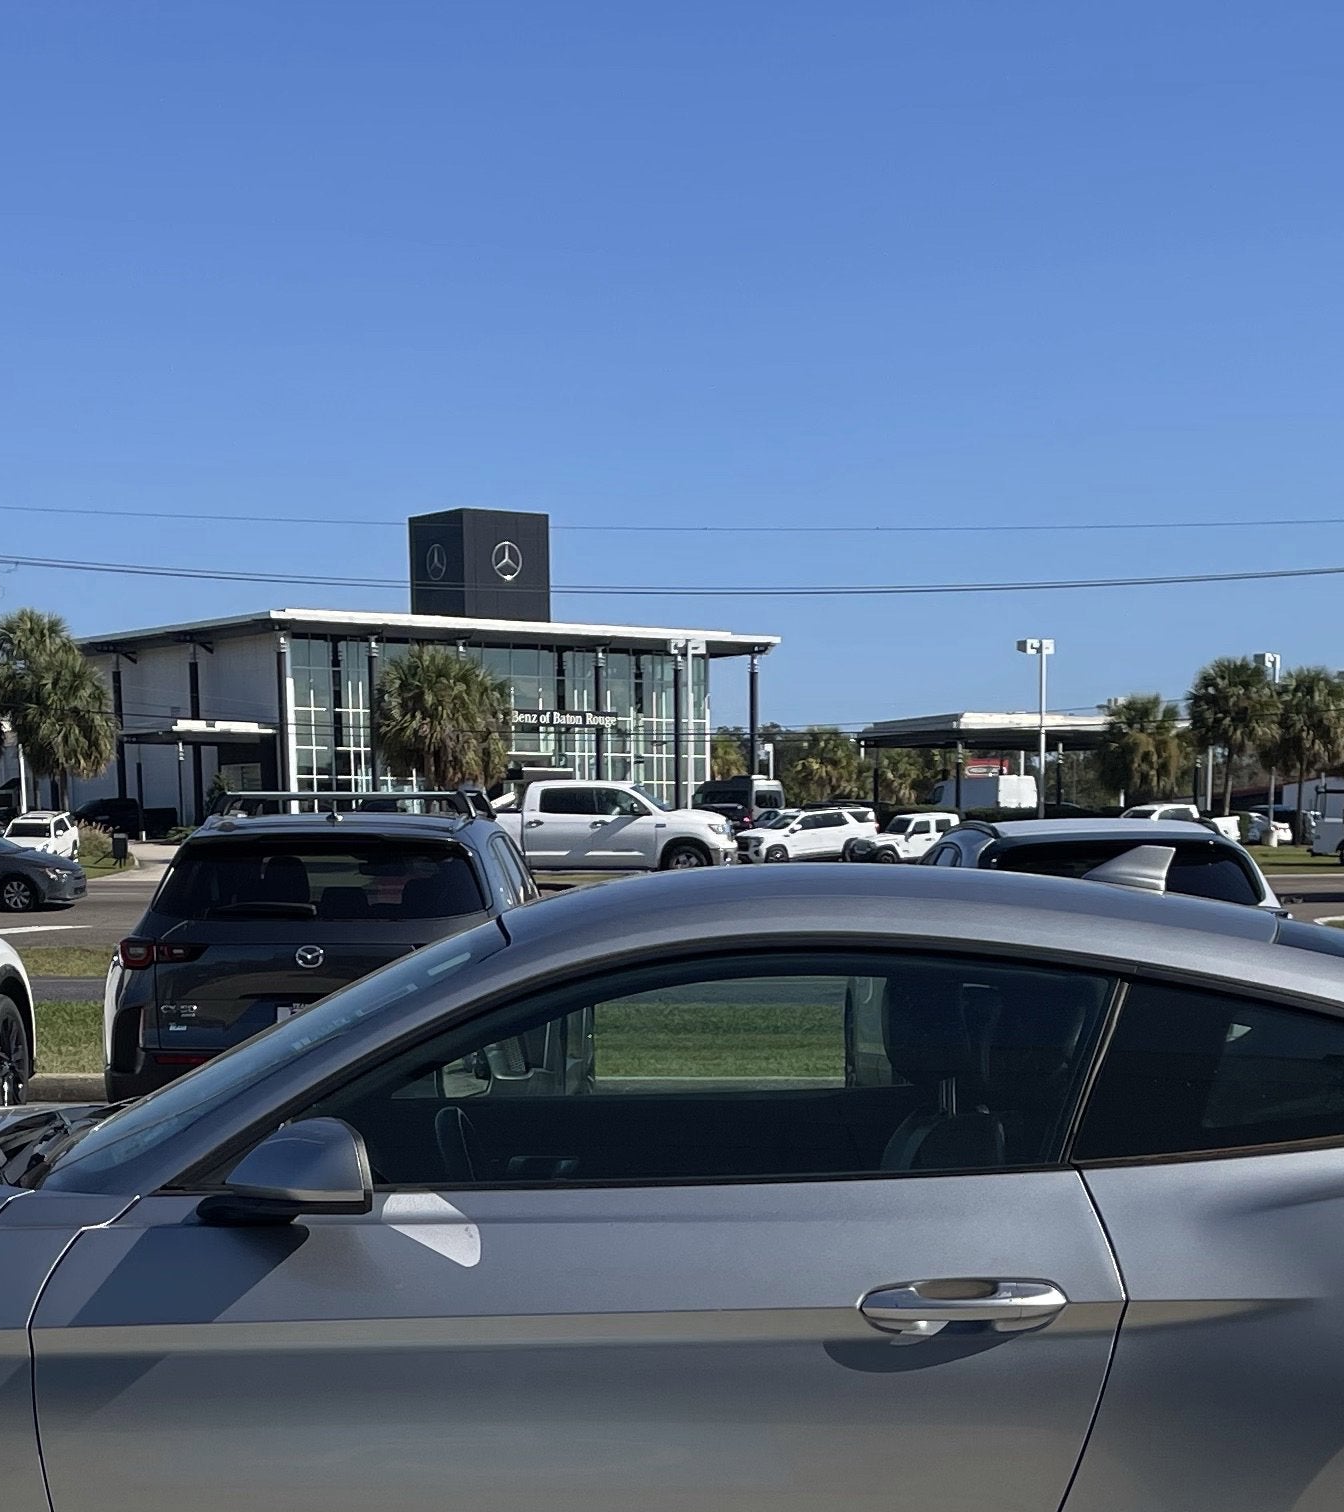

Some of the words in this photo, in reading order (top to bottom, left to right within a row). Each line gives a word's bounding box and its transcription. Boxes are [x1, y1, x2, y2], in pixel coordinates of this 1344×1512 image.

[512, 711, 537, 723] Benz
[539, 712, 550, 724] of
[553, 712, 582, 725] Baton
[586, 713, 617, 727] Rouge
